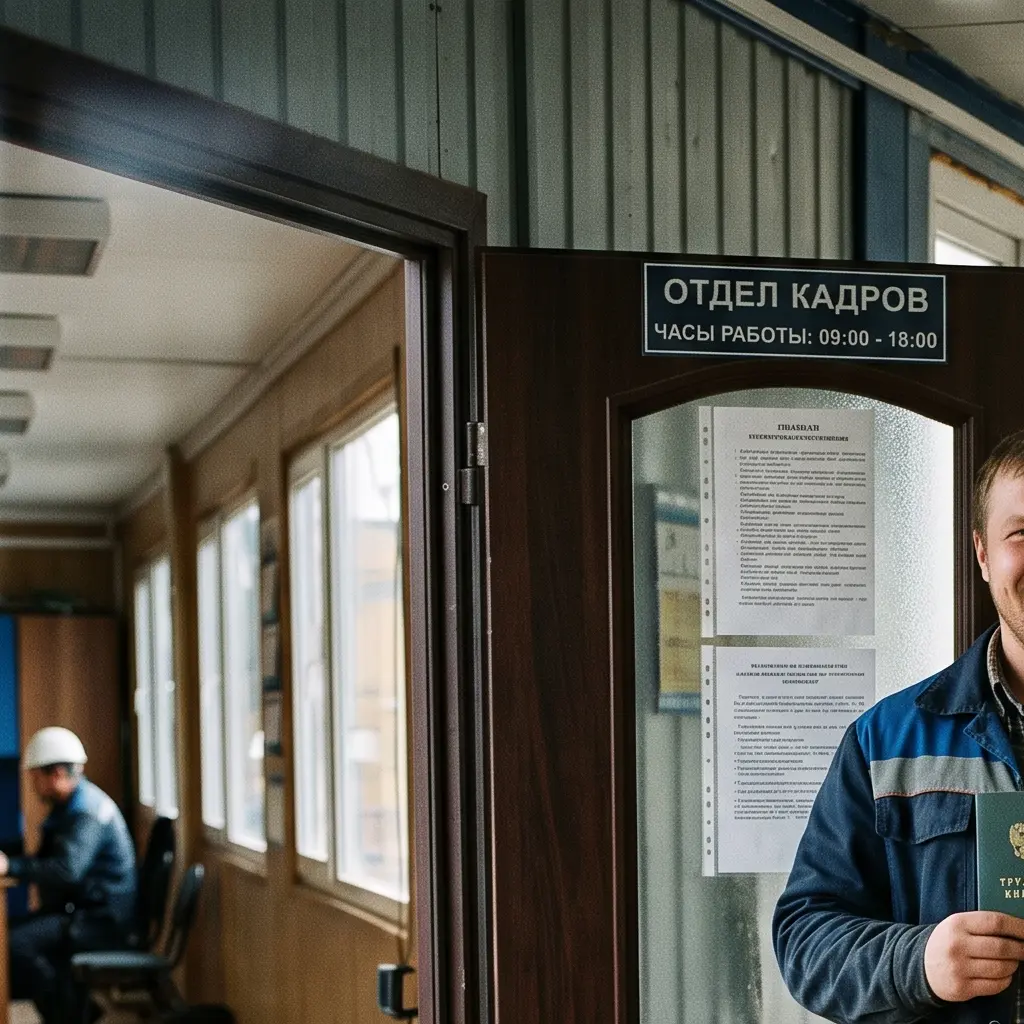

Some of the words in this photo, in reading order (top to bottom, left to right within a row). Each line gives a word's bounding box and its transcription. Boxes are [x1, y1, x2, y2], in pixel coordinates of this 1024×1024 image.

[664, 278, 778, 311] ОТДЕЛ
[792, 283, 929, 315] КАДРОВ
[654, 323, 715, 341] ЧАСЫ
[721, 325, 812, 345] РАБОТЫ:
[819, 328, 869, 346] 09:00
[888, 330, 937, 349] 18:00
